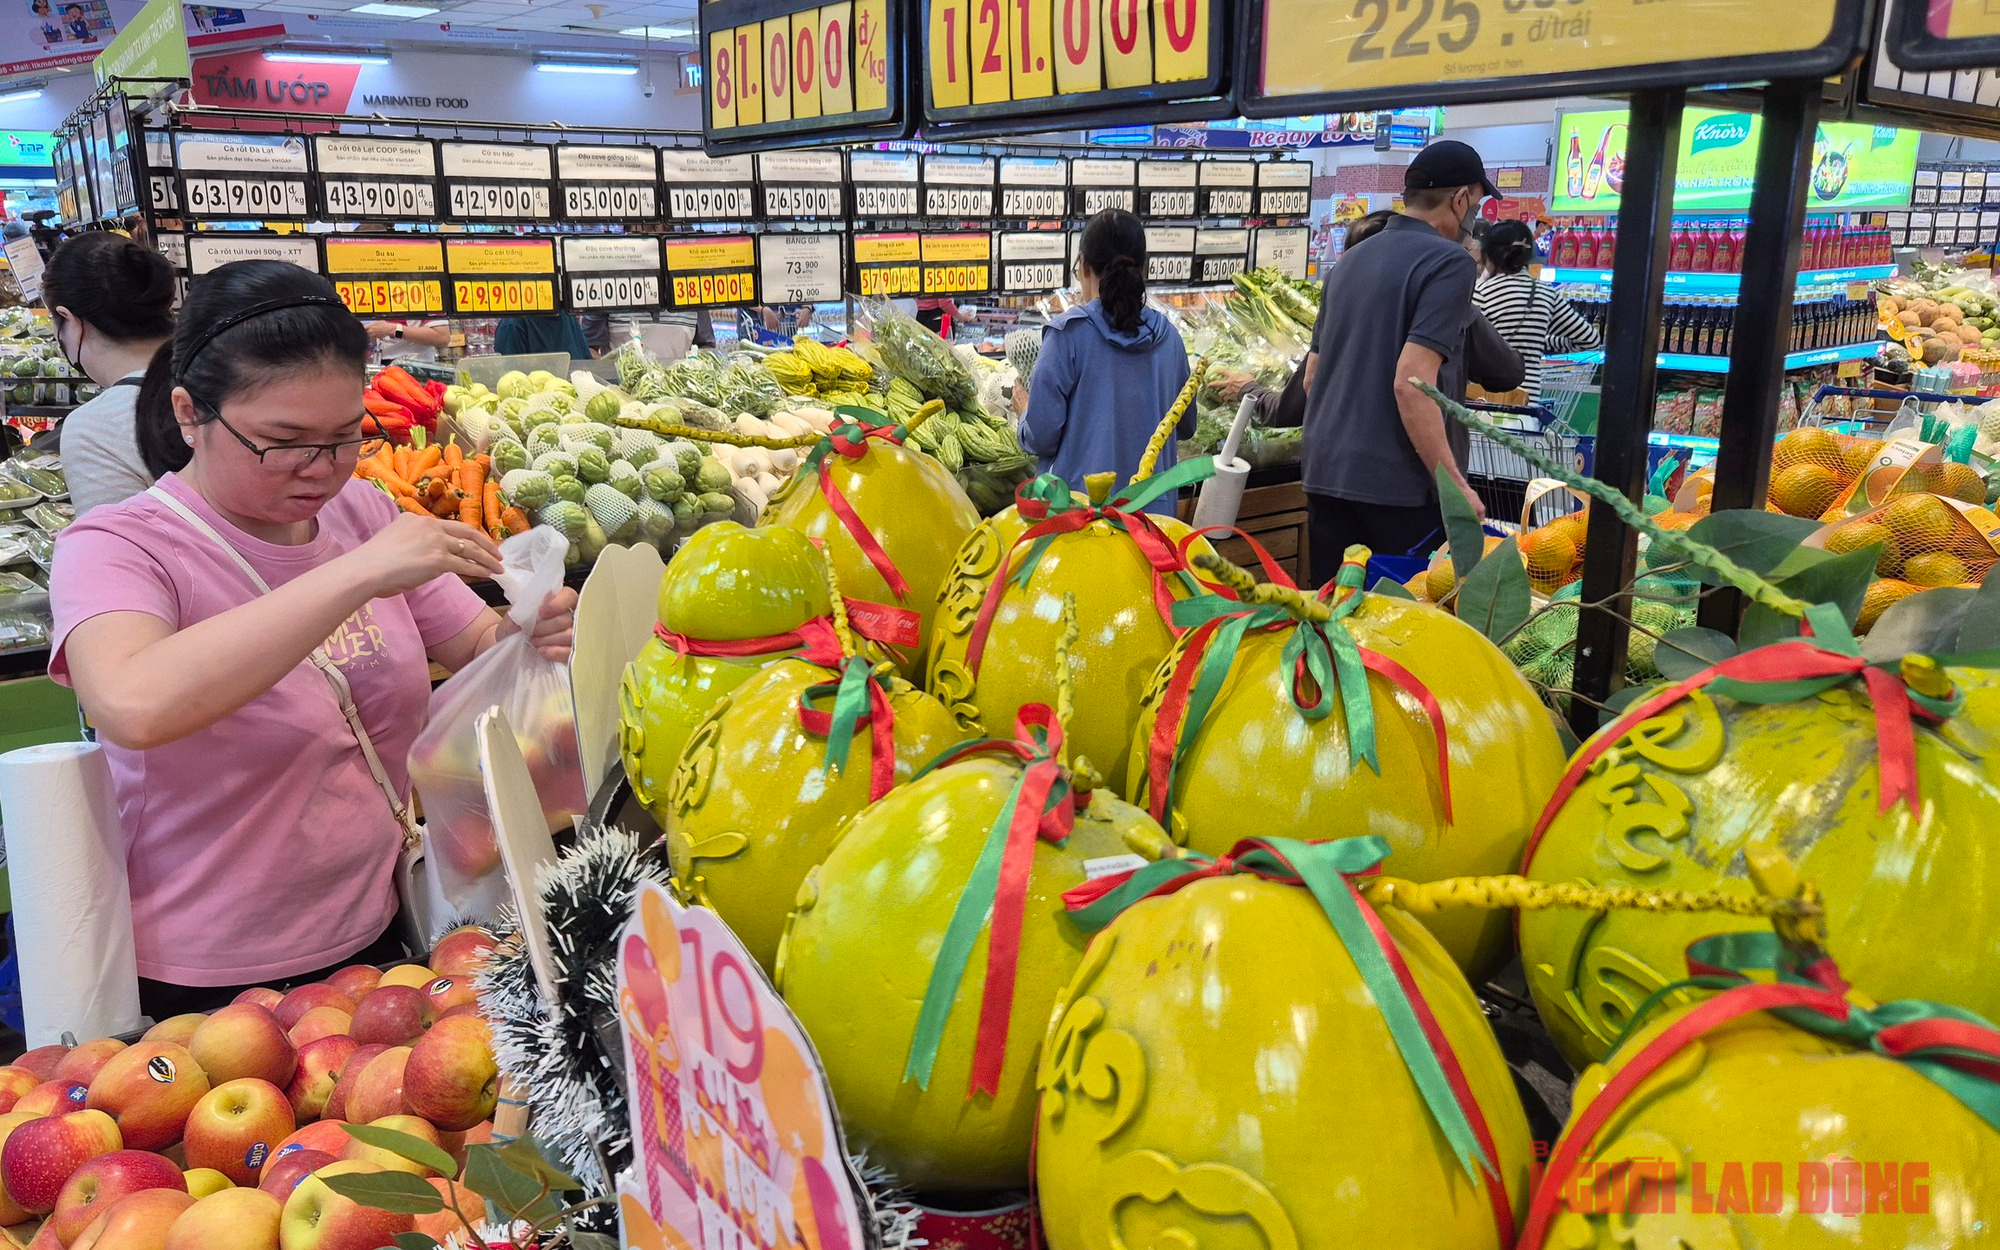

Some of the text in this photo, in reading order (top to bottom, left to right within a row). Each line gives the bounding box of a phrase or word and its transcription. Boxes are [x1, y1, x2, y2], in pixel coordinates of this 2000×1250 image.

[716, 20, 842, 109] 81.000
[201, 65, 330, 104] TẨM ƯỚP
[363, 94, 469, 109] MARINATED FOOD
[1251, 131, 1317, 148] Ready
[1695, 124, 1747, 141] Knorr
[376, 146, 398, 154] COOP
[399, 147, 421, 155] Select
[191, 184, 282, 207] 63.900
[330, 186, 414, 209] 43.900
[454, 189, 531, 211] 42.900
[569, 191, 638, 210] 85.000
[675, 192, 736, 211] 10.900
[769, 192, 826, 210] 26.500
[858, 191, 906, 209] 83.900
[928, 193, 979, 210] 63.500
[1004, 193, 1052, 210] 75.000
[1086, 194, 1121, 210] 6.500
[1209, 194, 1242, 210] 7.900
[1263, 195, 1299, 210] 19.500
[263, 248, 282, 256] 500g
[926, 270, 976, 287] 55.000
[1008, 268, 1053, 284] 10.500
[340, 285, 422, 306] 32.500
[459, 285, 533, 305] 29.900
[576, 282, 642, 301] 66.000
[677, 279, 738, 298] 38.900
[679, 927, 764, 1084] 19
